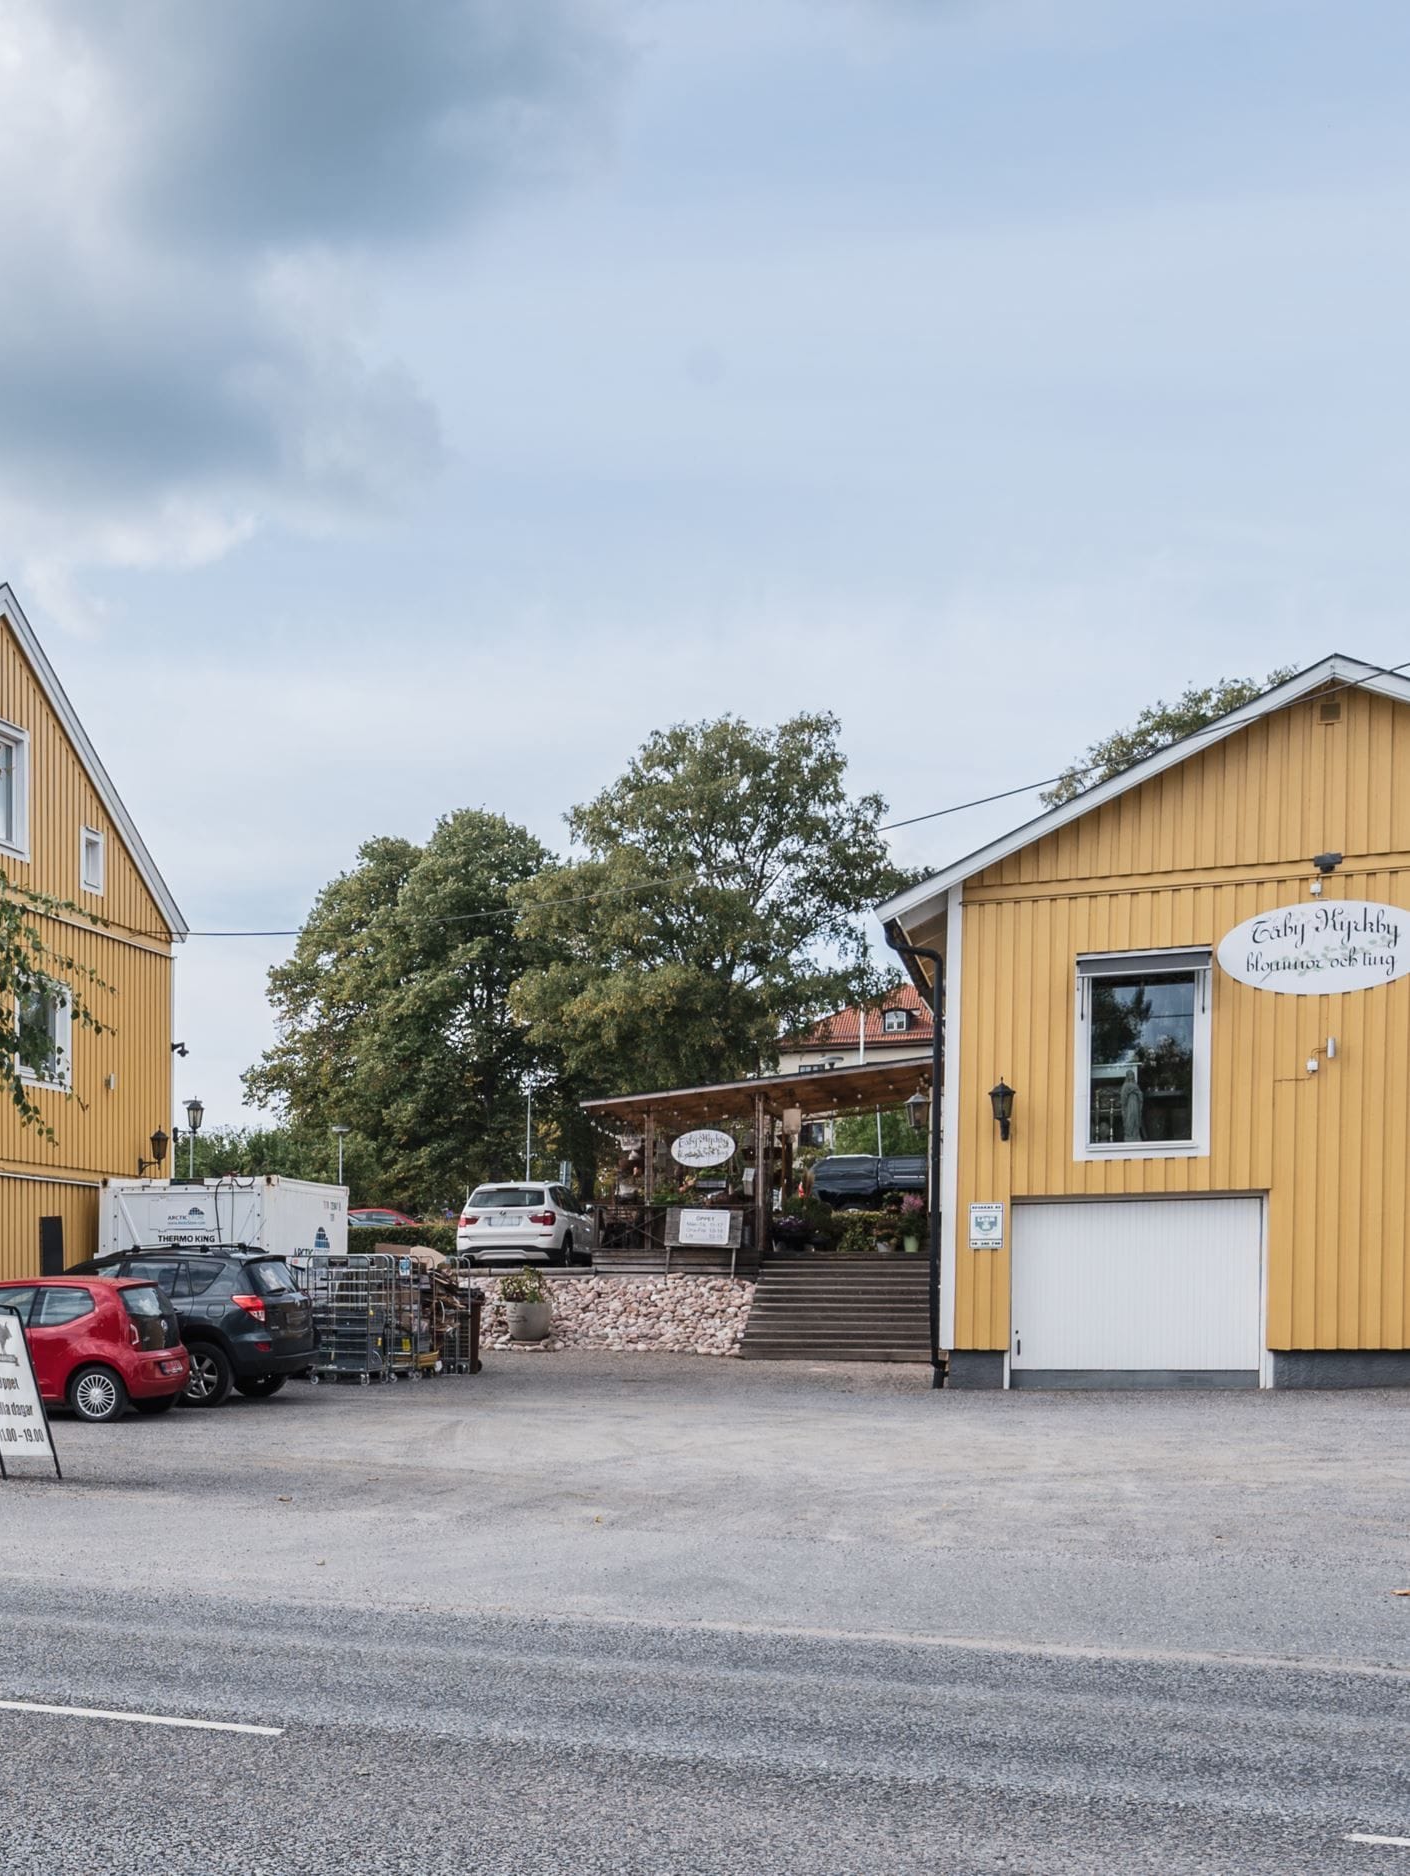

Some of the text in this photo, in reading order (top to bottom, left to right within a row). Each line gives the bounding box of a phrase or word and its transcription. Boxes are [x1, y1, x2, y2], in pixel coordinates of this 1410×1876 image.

[1252, 907, 1398, 949] Täby Kyrkby
[1330, 947, 1358, 968] och
[1362, 951, 1396, 977] ting
[158, 1235, 215, 1243] THERMO KING
[11, 1401, 34, 1417] dagar
